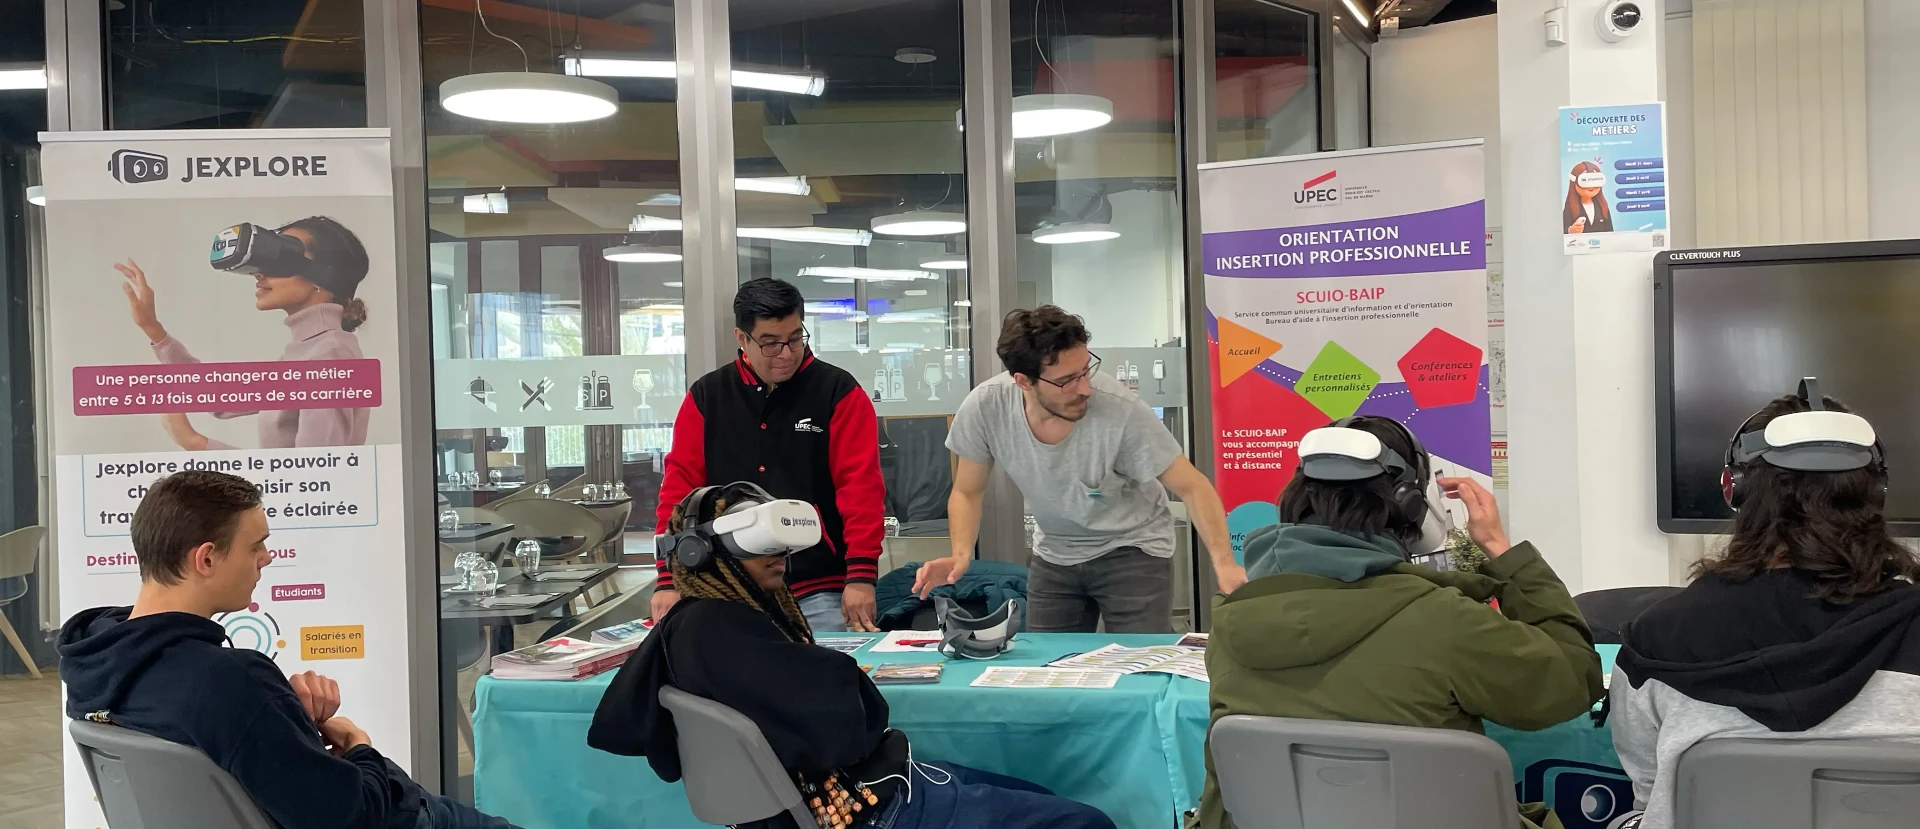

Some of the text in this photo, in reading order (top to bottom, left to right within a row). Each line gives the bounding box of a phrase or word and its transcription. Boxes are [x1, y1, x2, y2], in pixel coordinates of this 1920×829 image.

[1577, 114, 1645, 125] DÉCOUVERTE DES
[1592, 123, 1637, 136] MÉTIERS
[181, 156, 327, 183] JEXPLORE
[1294, 189, 1337, 203] UPEC
[1279, 226, 1399, 247] ORIENTATION
[1216, 241, 1471, 270] INSERTION PROFESSIONNELLE
[1670, 250, 1741, 260] CLEVERTOUCH PLUS
[1296, 287, 1385, 304] SCUIO-BAIP
[1294, 306, 1339, 315] universitaire
[1341, 303, 1392, 312] d'information
[1403, 301, 1453, 310] d'orientation
[1322, 314, 1359, 322] l'insertion
[1361, 311, 1420, 321] professionnelle
[1227, 347, 1261, 356] Accueil
[1411, 361, 1473, 371] Conférences
[96, 367, 354, 387] Une personne changera de métier
[1313, 373, 1362, 382] Entretiens
[1418, 372, 1468, 382] & ateliers
[1305, 383, 1371, 394] personnalisés
[79, 387, 373, 407] entre 5 à 13 fois au cours de sa carrière
[1222, 428, 1287, 438] Le SCUIO-BAIP
[1246, 440, 1300, 450] accompagn
[1236, 450, 1283, 460] présentiel
[95, 452, 359, 479] Jexplore donne le pouvoir à
[1234, 461, 1240, 469] à
[1242, 461, 1282, 470] distance
[127, 484, 149, 499] ch
[299, 480, 331, 493] son
[283, 501, 358, 518] éclairée
[86, 548, 296, 567] Destin ous
[275, 587, 322, 598] Étudiants
[305, 631, 361, 641] Salariés en
[310, 646, 358, 655] transition
